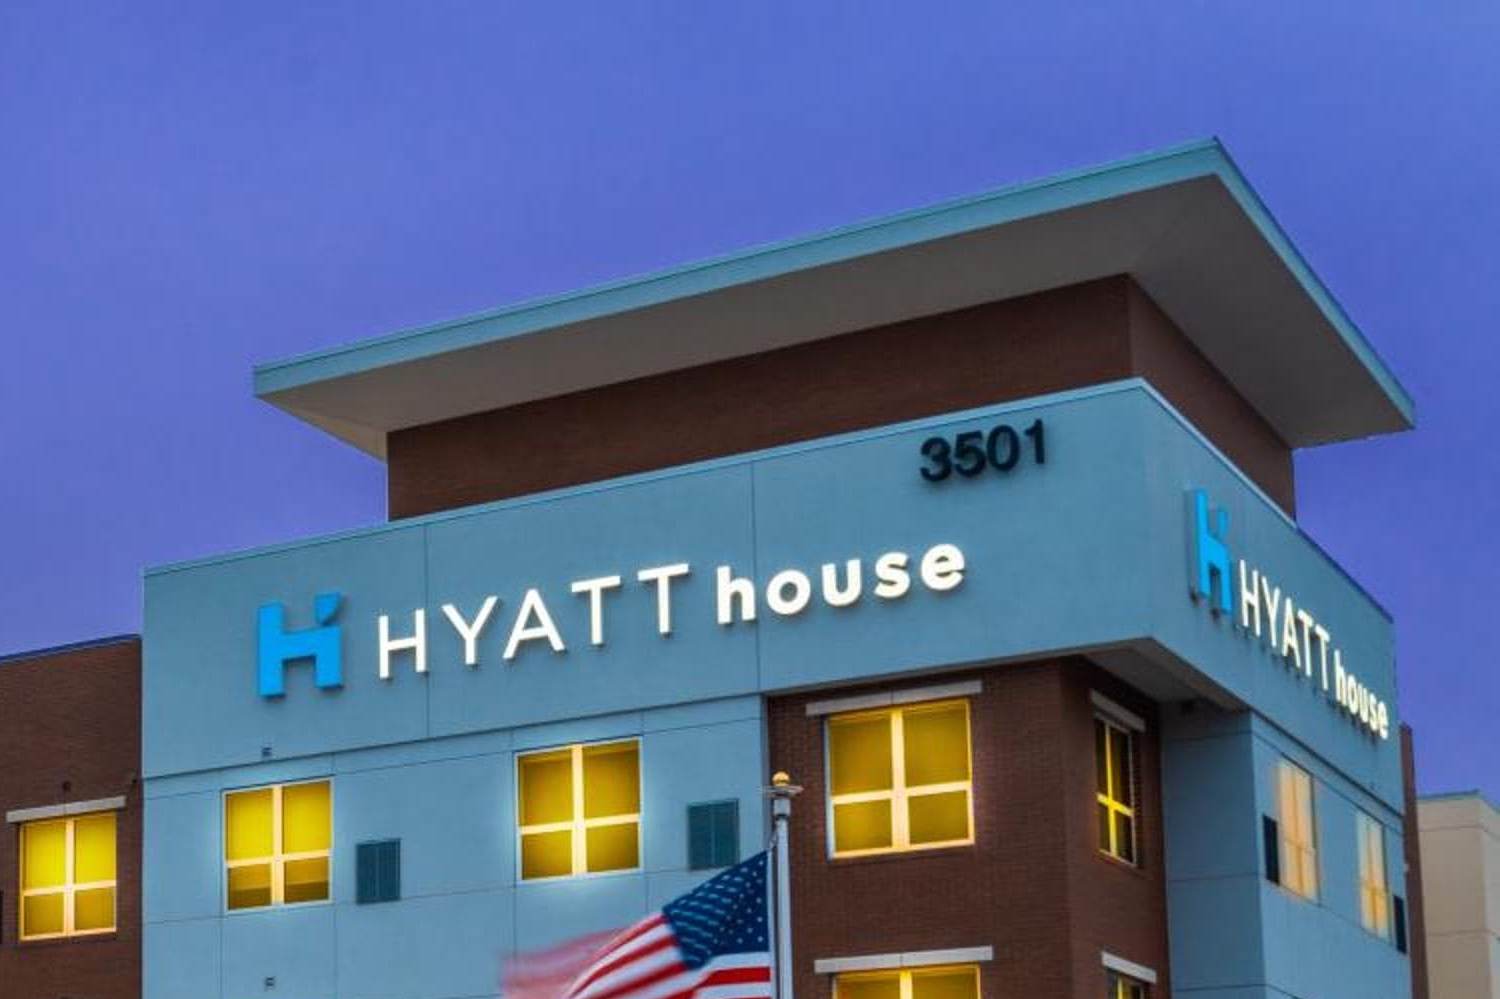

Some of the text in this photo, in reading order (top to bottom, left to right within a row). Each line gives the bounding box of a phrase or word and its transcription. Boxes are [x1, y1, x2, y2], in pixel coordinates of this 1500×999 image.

[920, 418, 1046, 482] 3501
[378, 563, 690, 680] HYATT
[716, 543, 966, 625] house
[1239, 559, 1331, 691] HYATT
[1333, 649, 1389, 741] house
